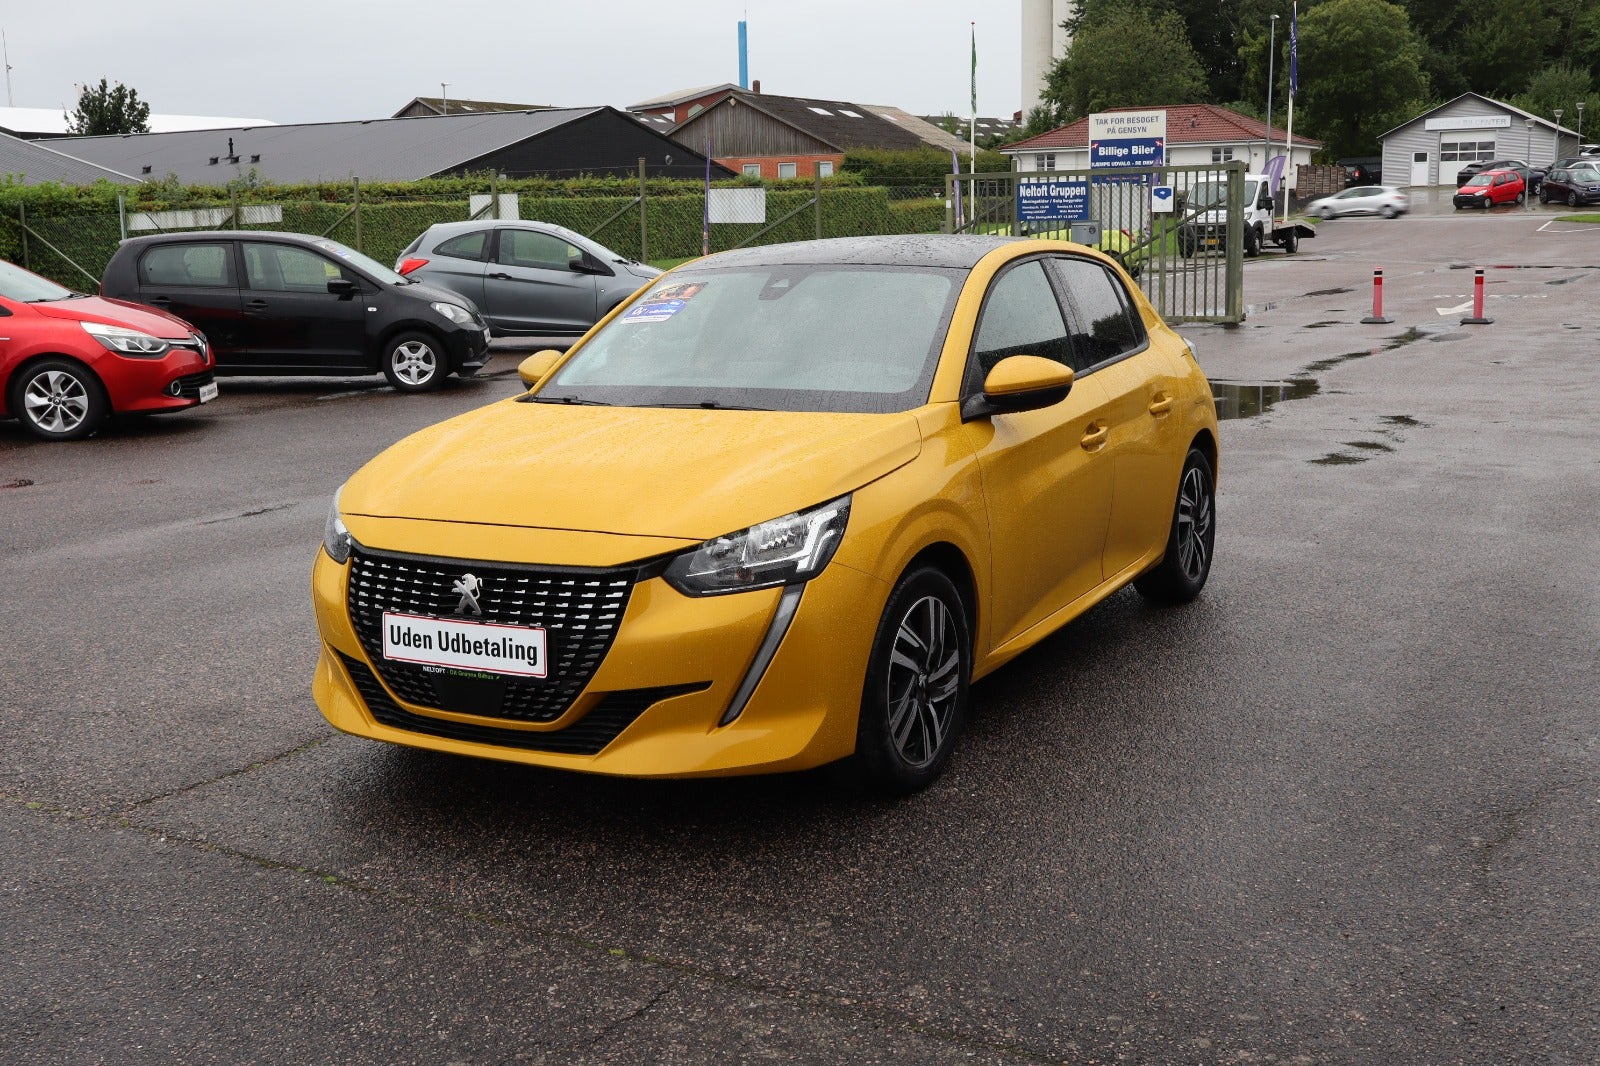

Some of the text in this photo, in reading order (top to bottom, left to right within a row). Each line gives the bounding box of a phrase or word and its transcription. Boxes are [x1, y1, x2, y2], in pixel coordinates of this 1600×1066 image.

[1099, 145, 1155, 156] Billige Biler
[1020, 184, 1086, 198] Neltoft Gruppen
[390, 625, 538, 666] Uden Udbetaling
[423, 665, 446, 674] NELTOFT
